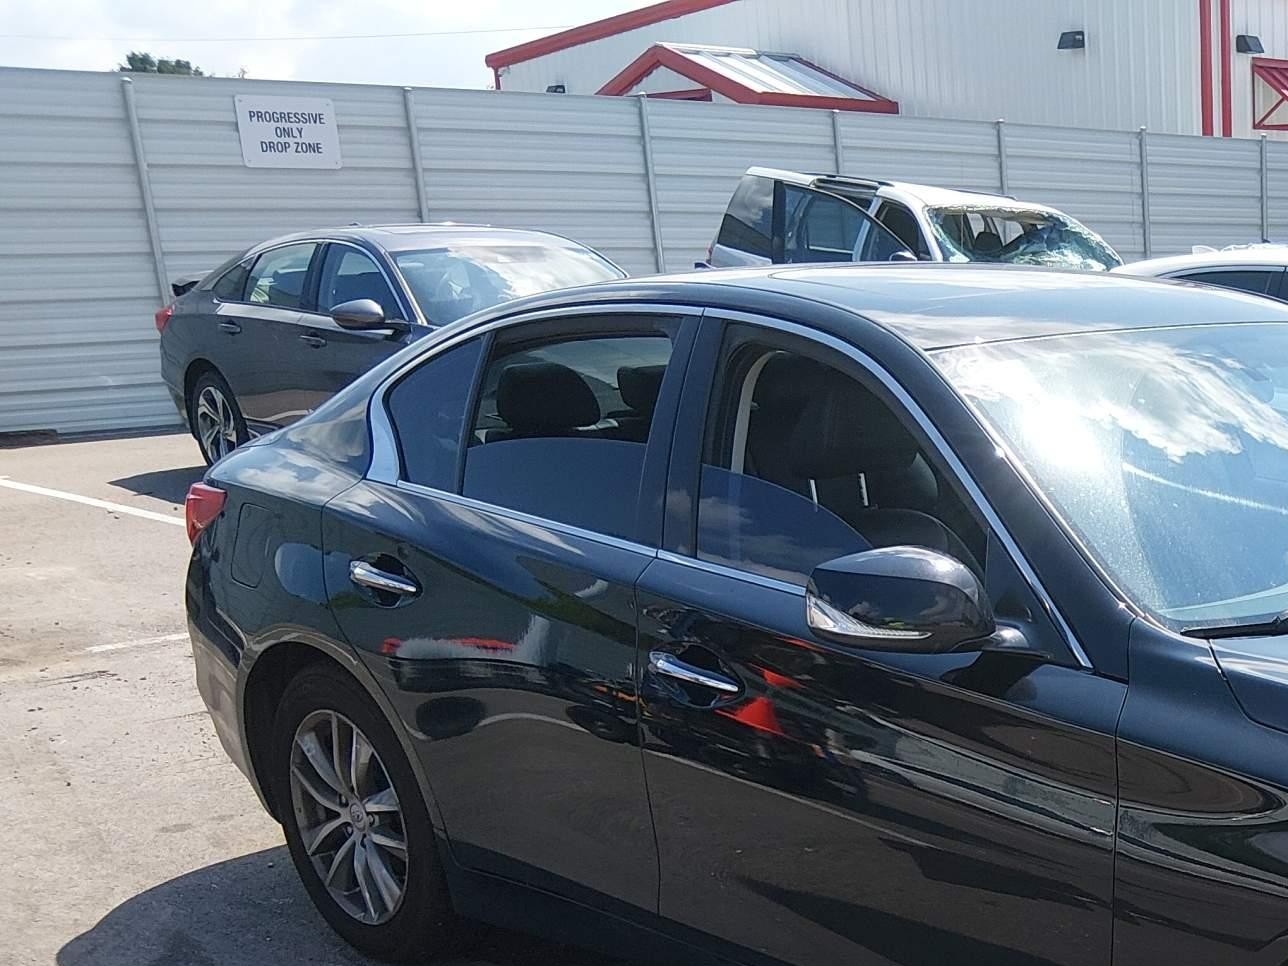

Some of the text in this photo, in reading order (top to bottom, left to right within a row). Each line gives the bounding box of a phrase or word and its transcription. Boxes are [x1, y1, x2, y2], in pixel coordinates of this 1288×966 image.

[248, 110, 326, 125] PROGRESSIVE
[275, 126, 303, 138] ONLY
[260, 141, 323, 154] DROP ZONE
